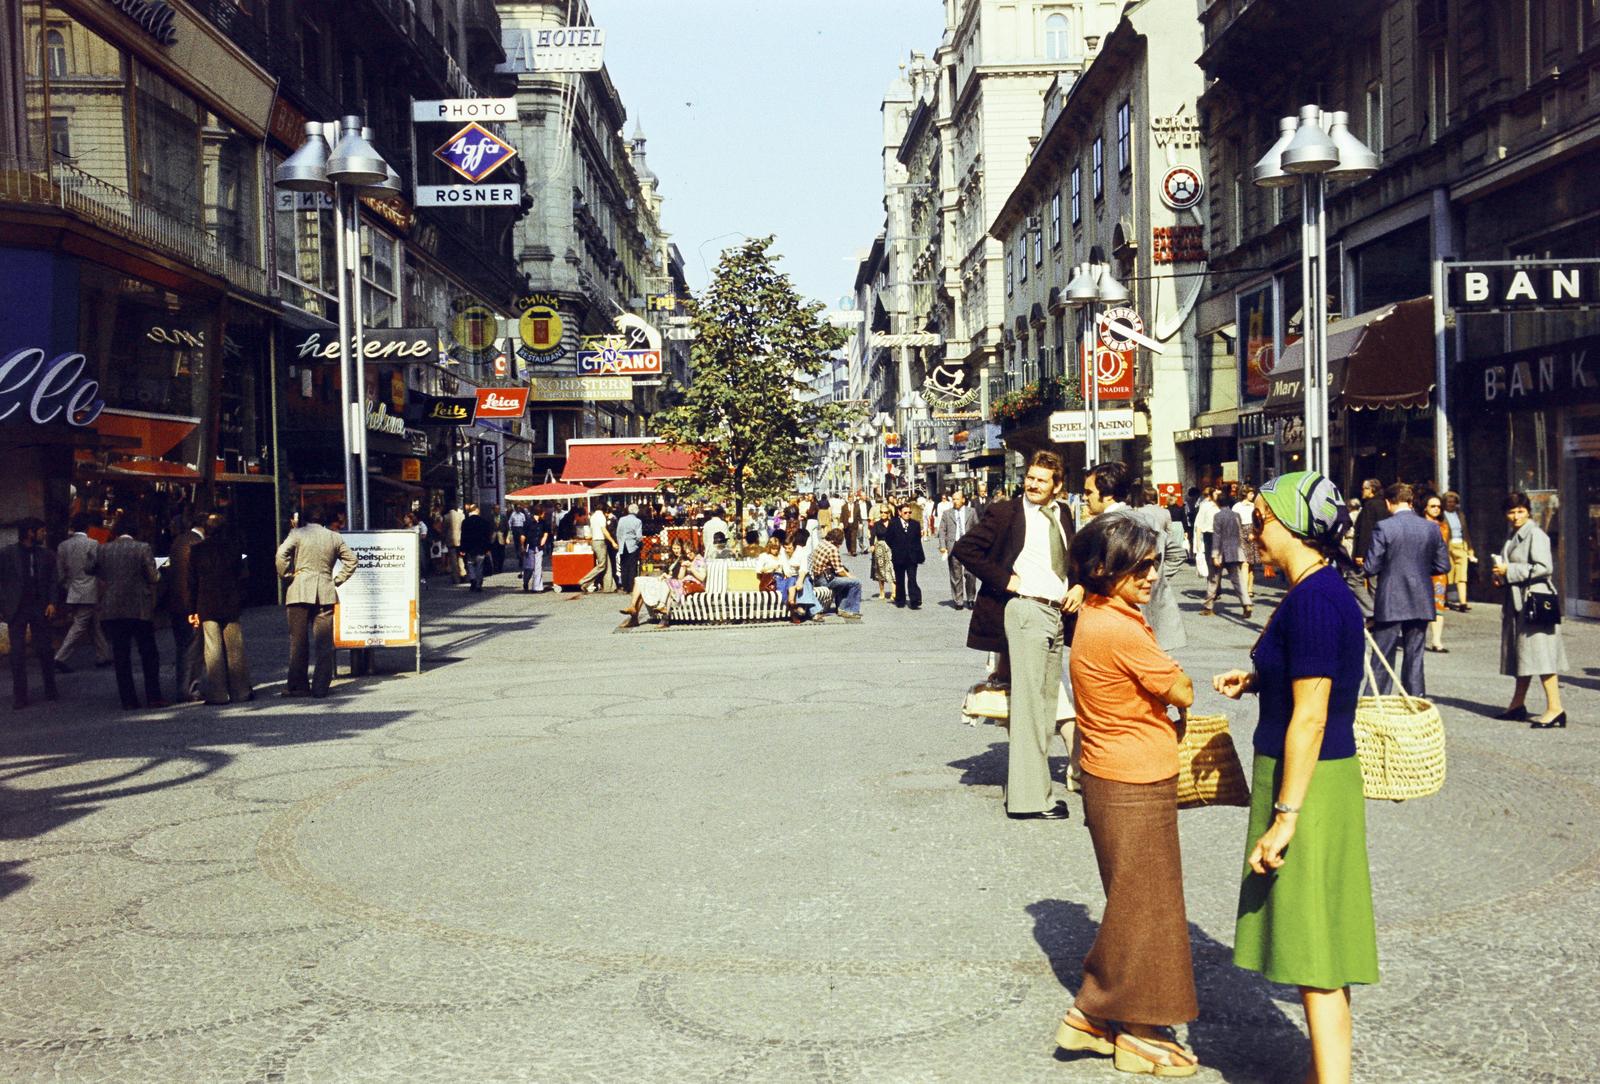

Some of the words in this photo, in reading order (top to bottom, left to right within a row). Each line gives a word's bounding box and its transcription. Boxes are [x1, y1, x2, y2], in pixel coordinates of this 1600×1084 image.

[537, 29, 602, 47] HOTEL
[438, 104, 506, 116] PHOTO
[442, 137, 499, 171] Agfa
[436, 189, 513, 202] ROSNER
[1465, 269, 1600, 302] BAN
[519, 294, 559, 309] CHINA
[296, 333, 432, 358] heene
[518, 348, 565, 363] RESTAURANT
[582, 353, 657, 370] CIANO
[538, 379, 630, 390] NORDSTERN
[1485, 350, 1588, 401] BANK
[1273, 380, 1300, 398] Mary
[430, 401, 468, 419] Leitz
[481, 392, 520, 411] Leica
[1052, 422, 1087, 432] SPIEL
[484, 446, 494, 485] BANK
